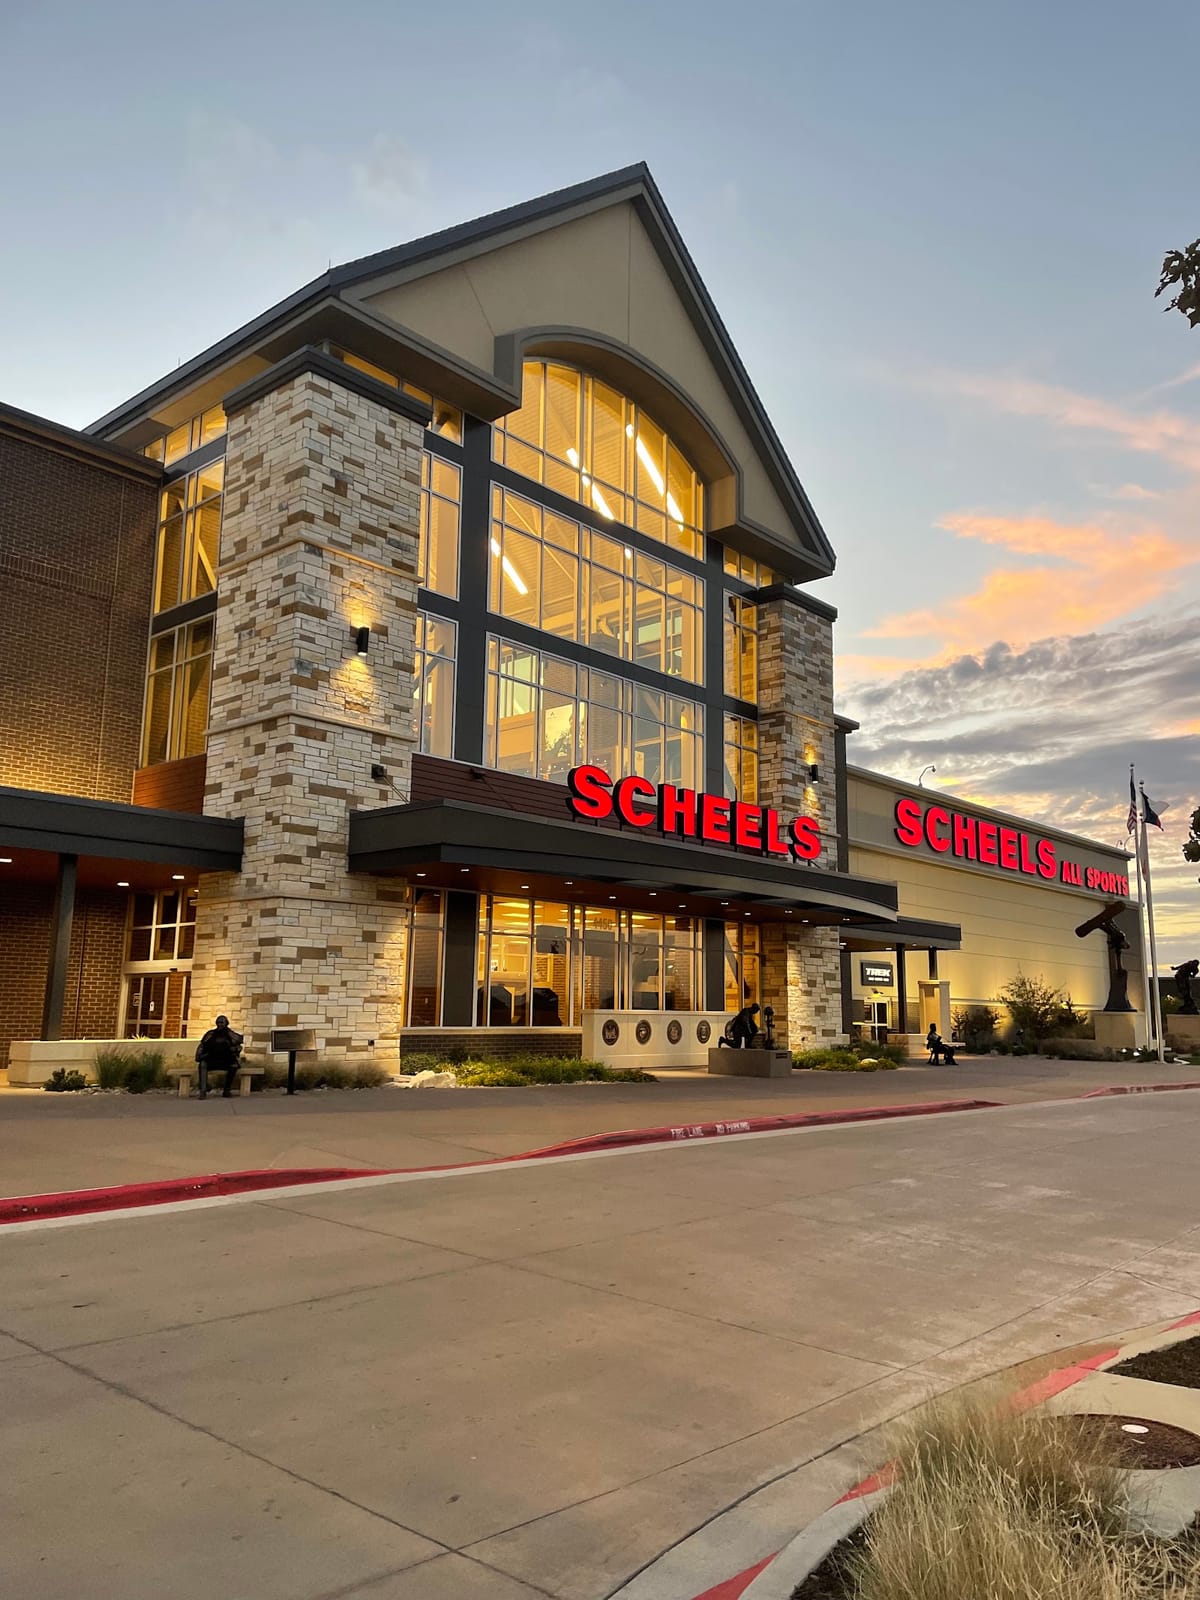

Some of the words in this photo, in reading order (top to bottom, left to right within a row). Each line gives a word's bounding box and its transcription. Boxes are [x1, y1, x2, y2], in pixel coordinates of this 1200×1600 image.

[567, 764, 822, 860] SCHEELS
[895, 799, 1057, 879] SCHEELS
[1061, 860, 1083, 886] ALL
[1085, 866, 1129, 896] SPORTS
[865, 967, 891, 977] TREK
[670, 1128, 686, 1139] FIRE
[687, 1126, 704, 1137] LANE
